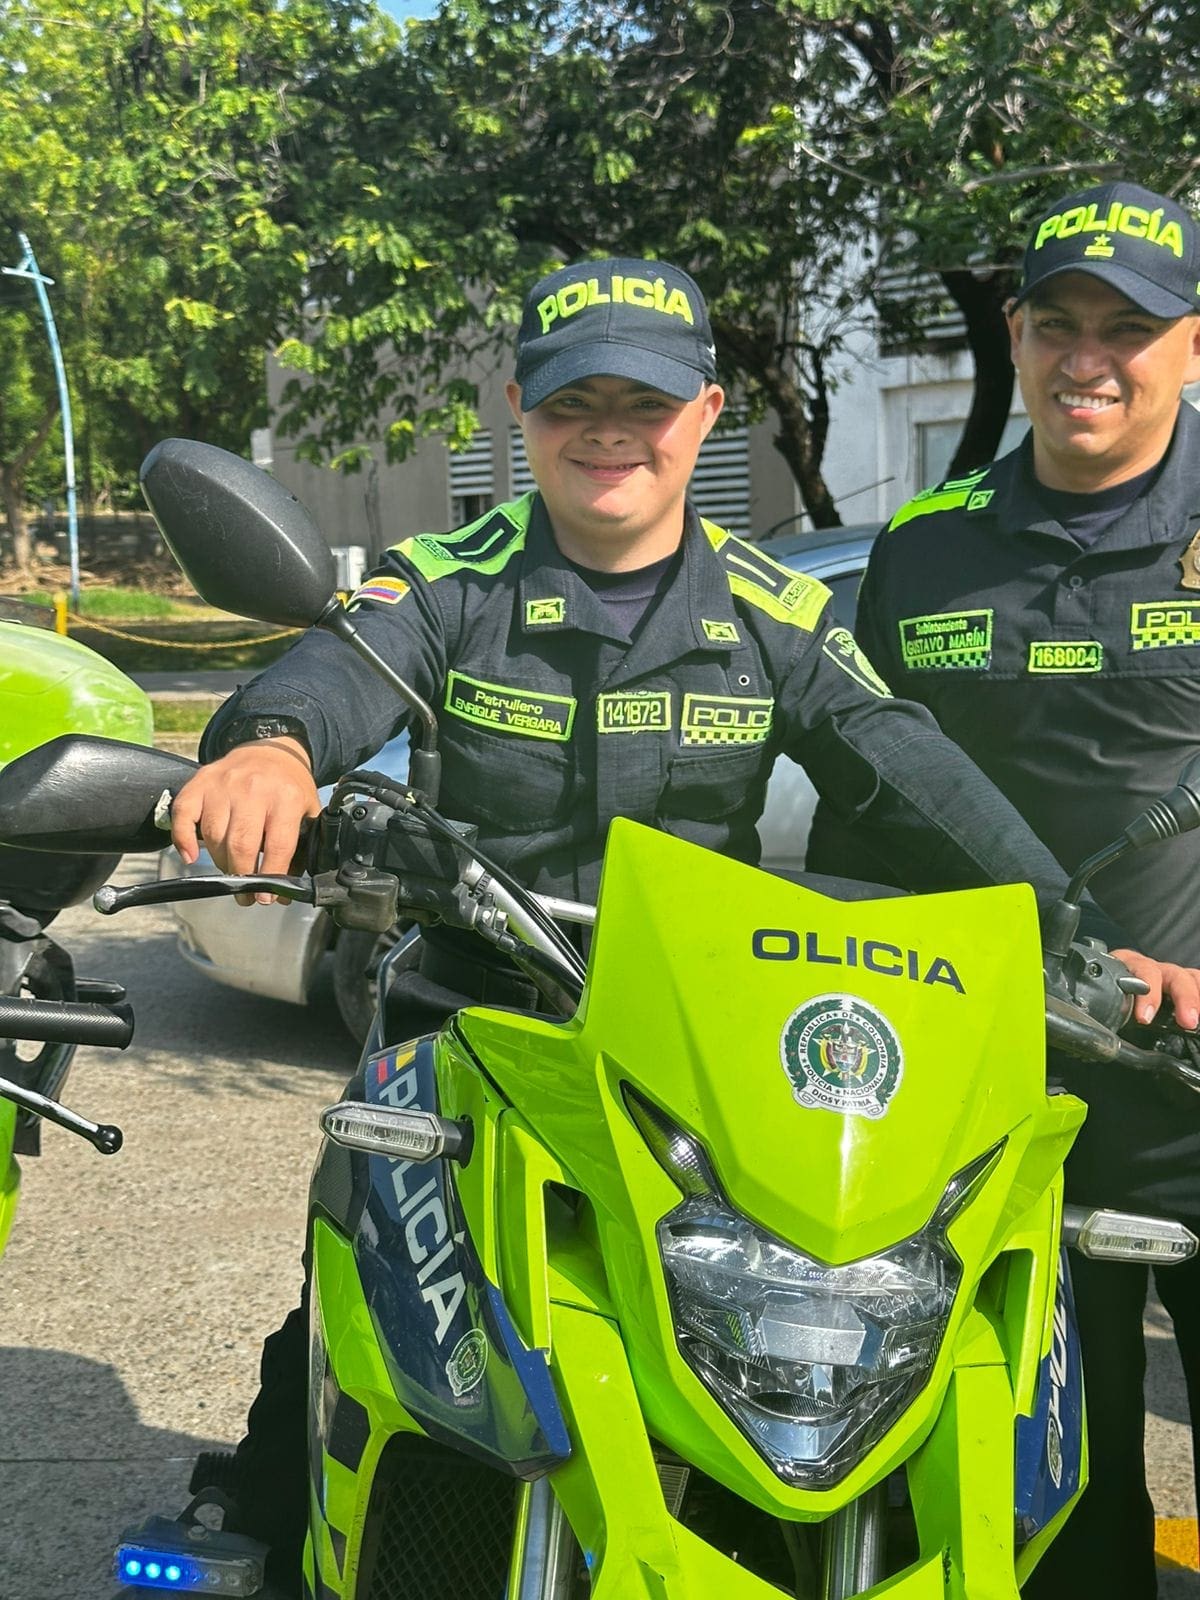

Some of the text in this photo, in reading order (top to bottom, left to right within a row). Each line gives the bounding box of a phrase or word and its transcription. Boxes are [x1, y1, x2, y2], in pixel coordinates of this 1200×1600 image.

[1034, 202, 1183, 258] POLICÍA
[537, 275, 694, 334] POLICÍA
[906, 626, 985, 655] GUSTAVO MARÍN
[1035, 647, 1097, 667] 168004
[455, 697, 562, 734] ENRIQUE VERGARA
[475, 690, 543, 715] Patrullero
[606, 701, 662, 725] 141872
[752, 928, 966, 995] OLICIA
[842, 1011, 855, 1020] DE
[804, 1064, 882, 1096] POLICIA NACIONAL
[379, 1067, 466, 1346] PLICÍA
